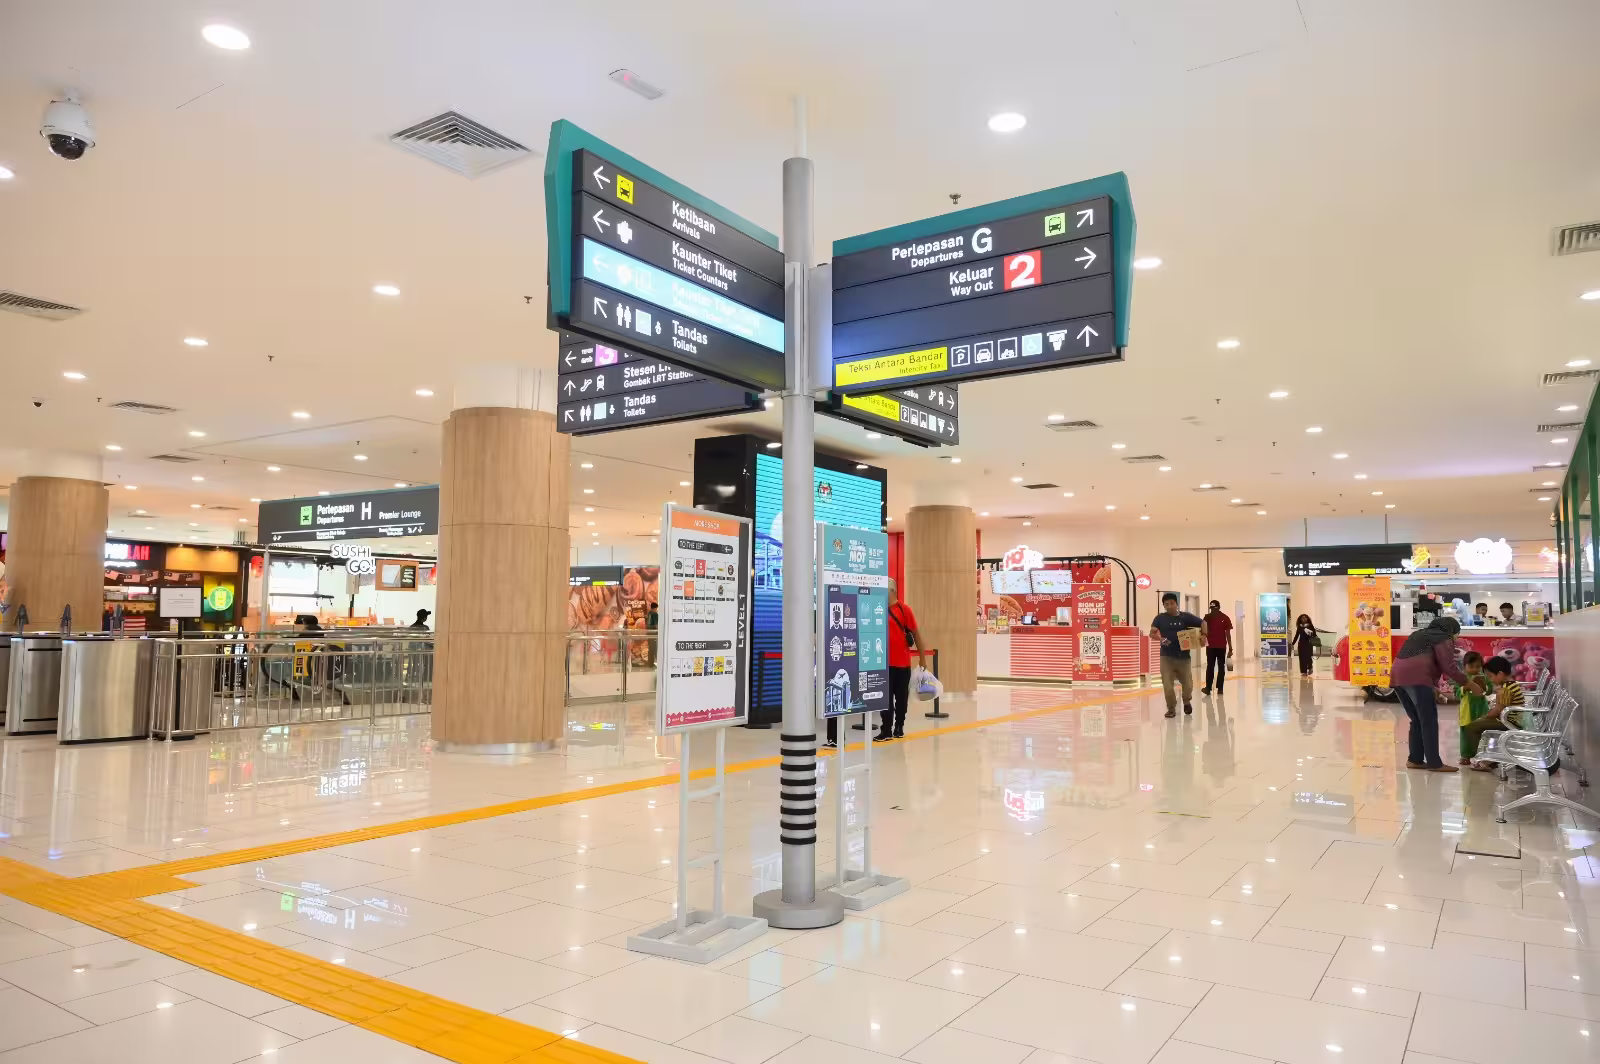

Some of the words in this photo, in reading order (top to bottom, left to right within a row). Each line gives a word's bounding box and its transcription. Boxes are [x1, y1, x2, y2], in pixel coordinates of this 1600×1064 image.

[672, 200, 716, 235] Ketibaan
[672, 218, 701, 240] Arrivals
[891, 235, 964, 261] Perlepasan
[971, 227, 993, 254] G
[672, 240, 712, 270] Kaunter
[713, 259, 738, 283] Tiket
[911, 250, 964, 269] Departures
[672, 257, 696, 277] Ticket
[696, 268, 729, 291] Counters
[949, 266, 994, 285] Keluar
[1009, 254, 1036, 289] 2
[951, 285, 972, 297] Way
[974, 280, 994, 291] Out
[672, 319, 709, 345] Tandas
[672, 337, 698, 355] Toilets
[623, 364, 656, 379] Stesen
[849, 364, 872, 374] Teksi
[874, 358, 905, 369] Antara
[909, 351, 943, 364] Bandar
[623, 375, 651, 389] Gombak
[652, 373, 666, 384] LRT
[623, 393, 657, 408] Tandas
[623, 407, 646, 418] Toilets
[316, 503, 355, 516] Perlepasan
[361, 501, 372, 521] H
[400, 509, 422, 519] Lounge
[333, 545, 371, 557] SUSHI
[349, 559, 374, 574] GO!
